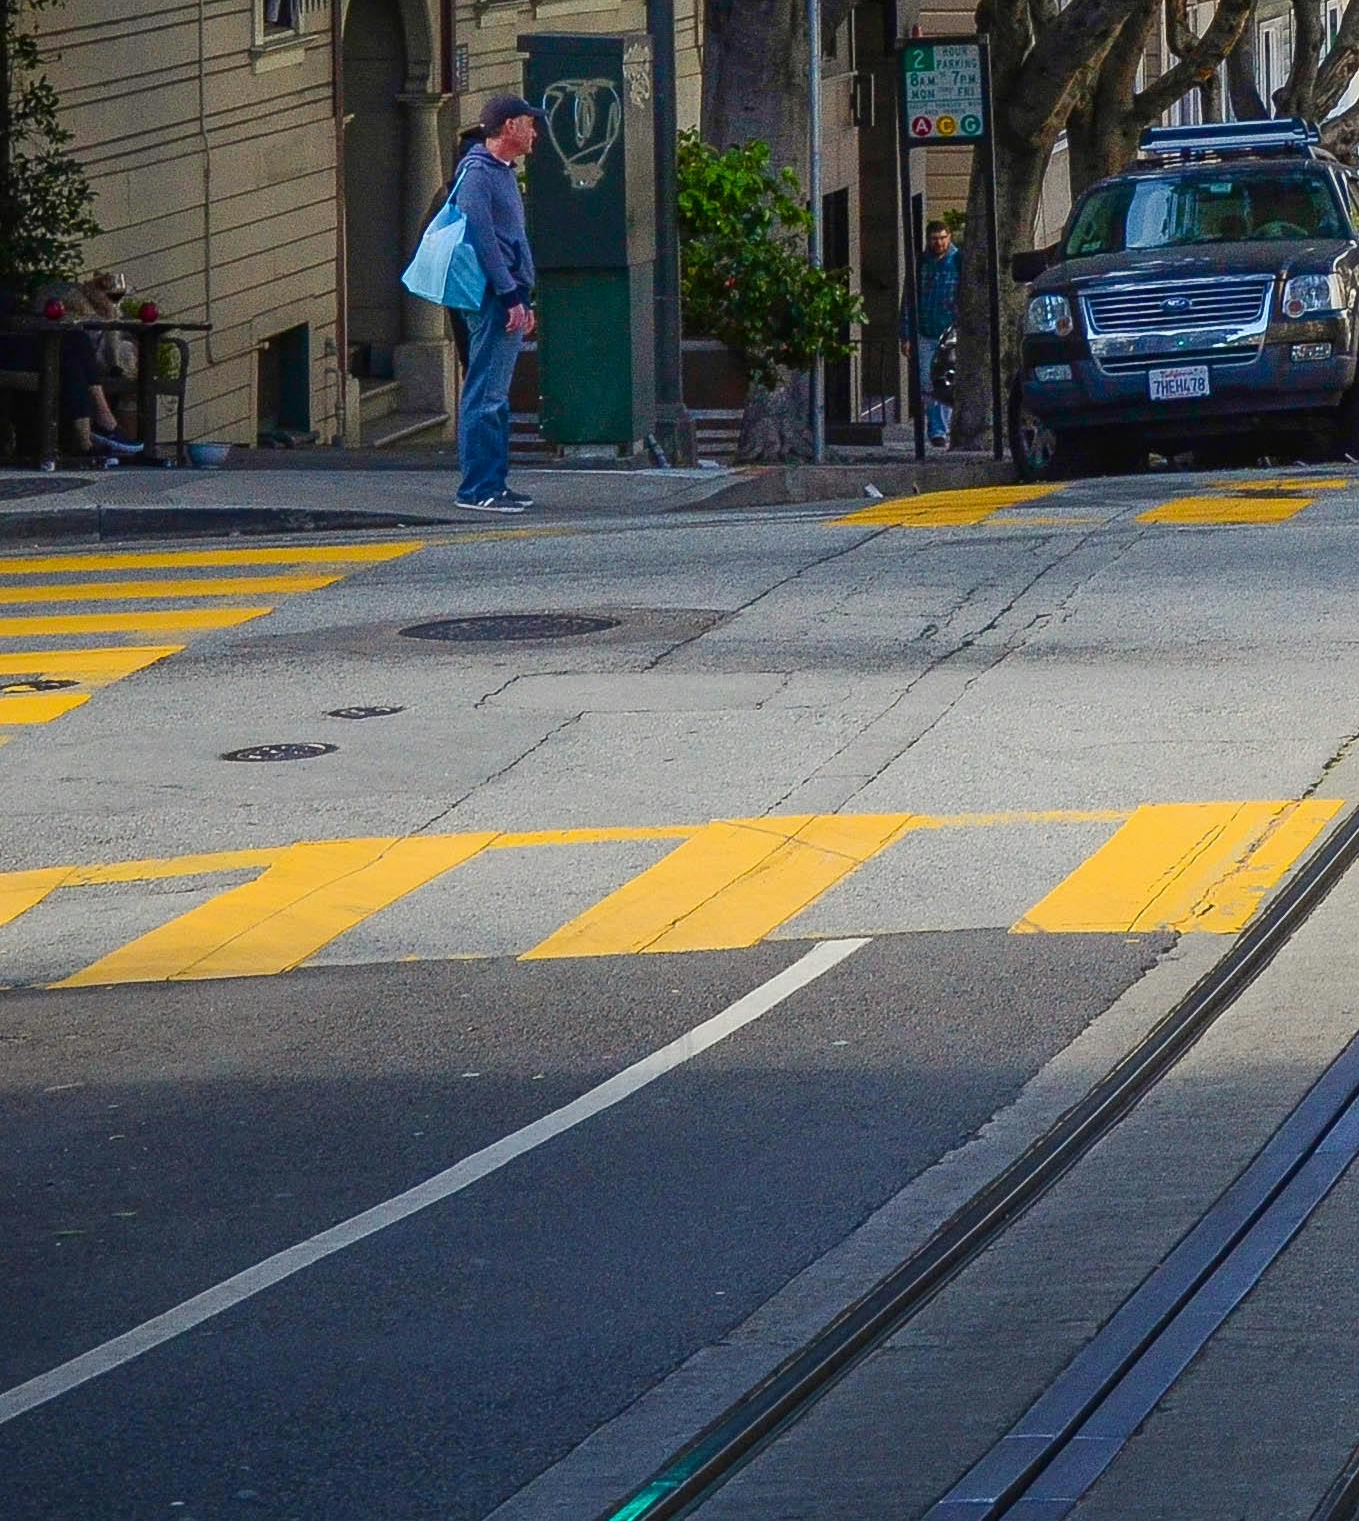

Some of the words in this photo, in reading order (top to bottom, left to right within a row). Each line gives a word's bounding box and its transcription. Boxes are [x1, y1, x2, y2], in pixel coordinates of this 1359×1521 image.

[913, 49, 925, 68] 2
[936, 59, 978, 68] PARKING
[915, 118, 929, 132] A
[940, 118, 953, 132] C
[965, 117, 977, 131] G
